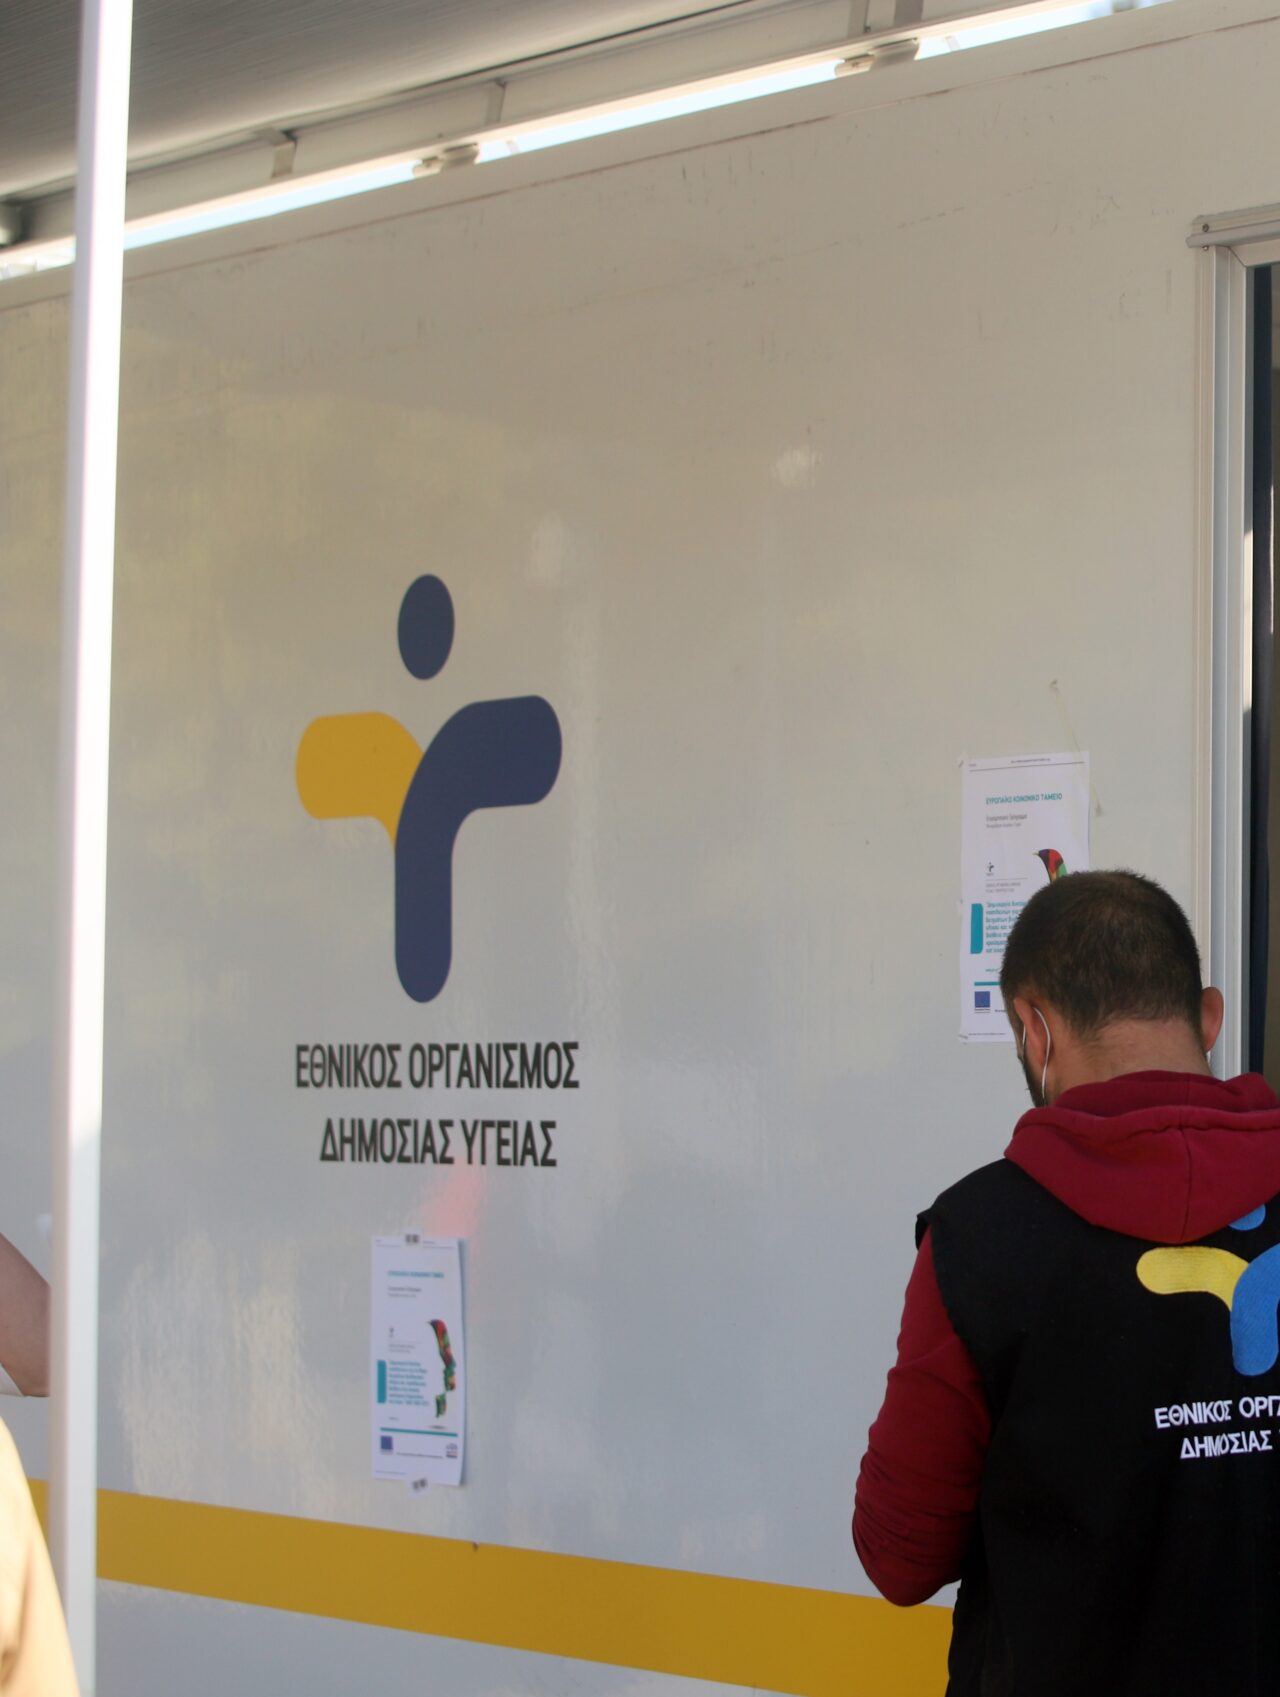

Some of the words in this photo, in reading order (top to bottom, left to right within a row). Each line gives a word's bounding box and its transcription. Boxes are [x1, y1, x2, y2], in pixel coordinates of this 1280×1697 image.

[296, 1044, 402, 1088] ΕΘΝΙΚΟΣ
[409, 1041, 580, 1089] ΟΡΓΑΝΙΣΜΟΣ
[320, 1118, 454, 1165] ΔΗΜΟΣΙΑΣ
[461, 1119, 557, 1167] ΥΓΕΙΑΣ
[1154, 1400, 1233, 1429] ΕΘΝΙΚΟΣ
[1180, 1430, 1273, 1459] ΔΗΜΟΣΙΑΣ
